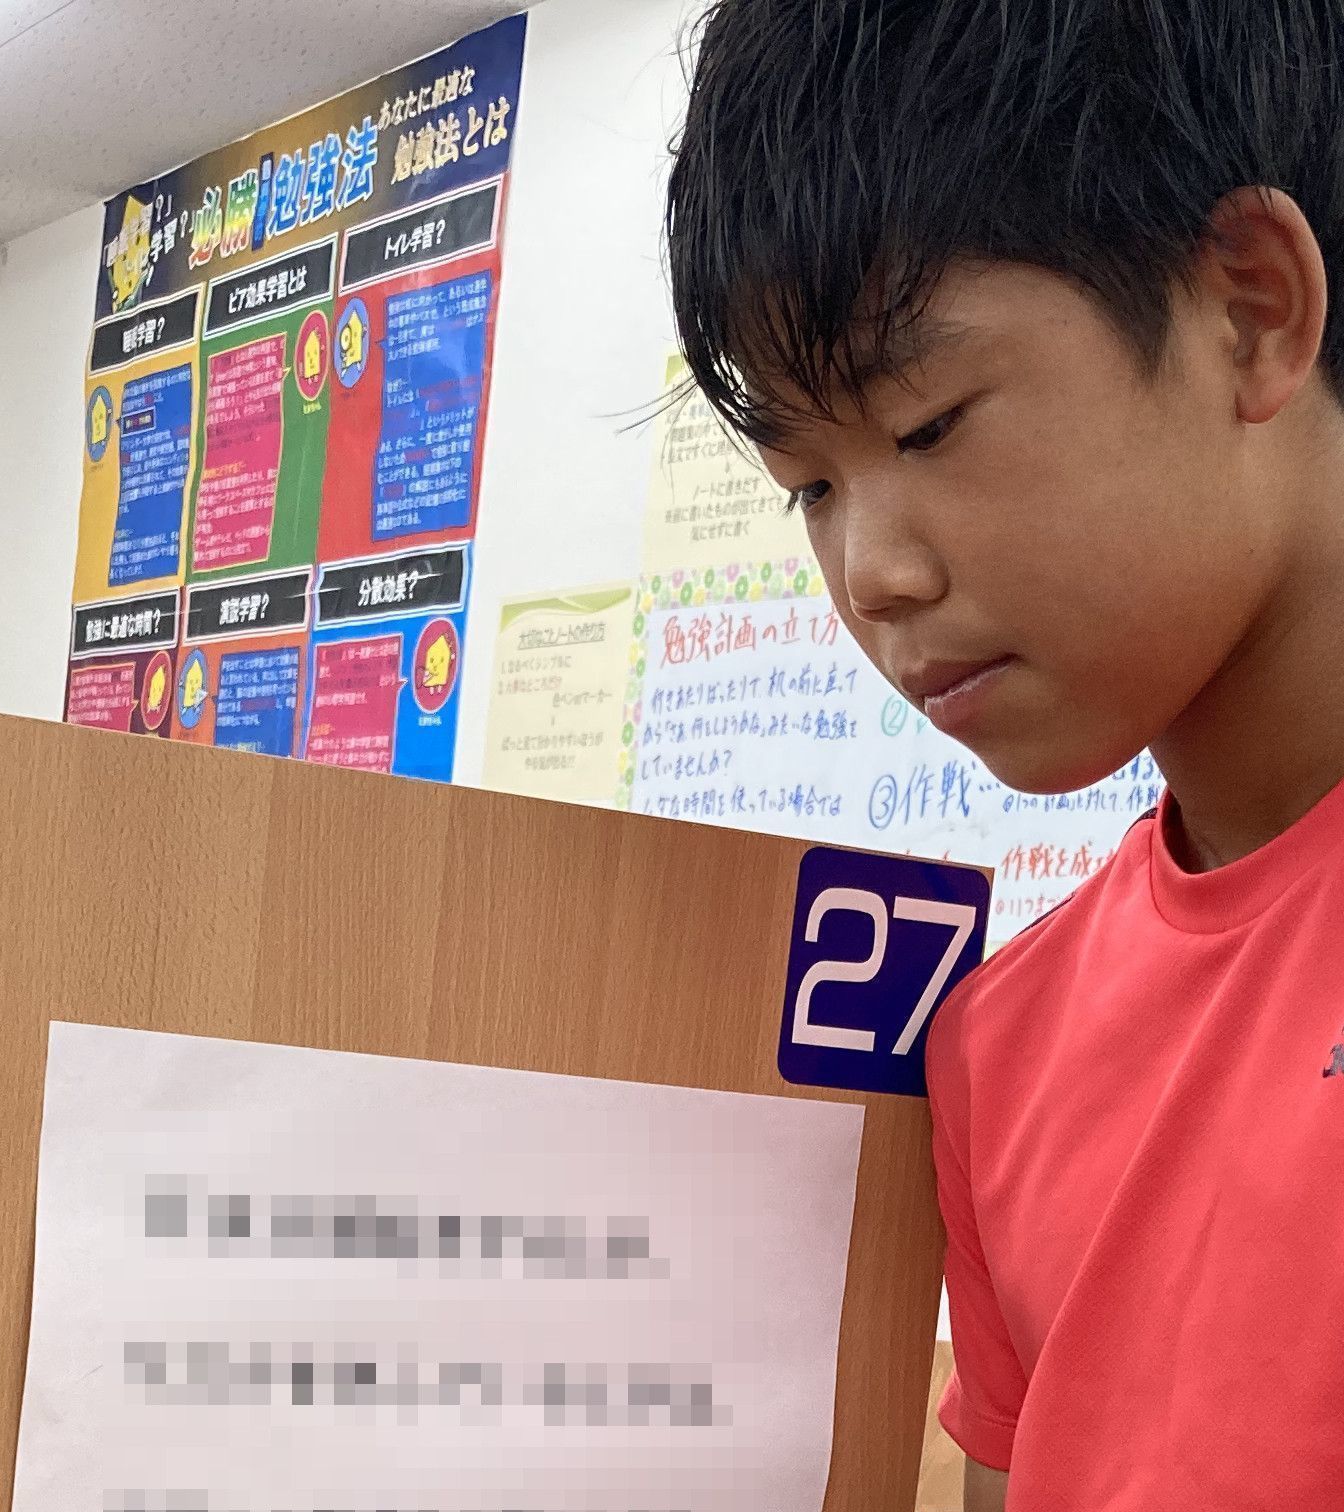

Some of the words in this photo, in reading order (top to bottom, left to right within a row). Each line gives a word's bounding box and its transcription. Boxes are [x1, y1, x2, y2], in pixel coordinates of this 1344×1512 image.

[660, 607, 839, 668] 勉強計画の立て方
[790, 886, 977, 1058] 27
